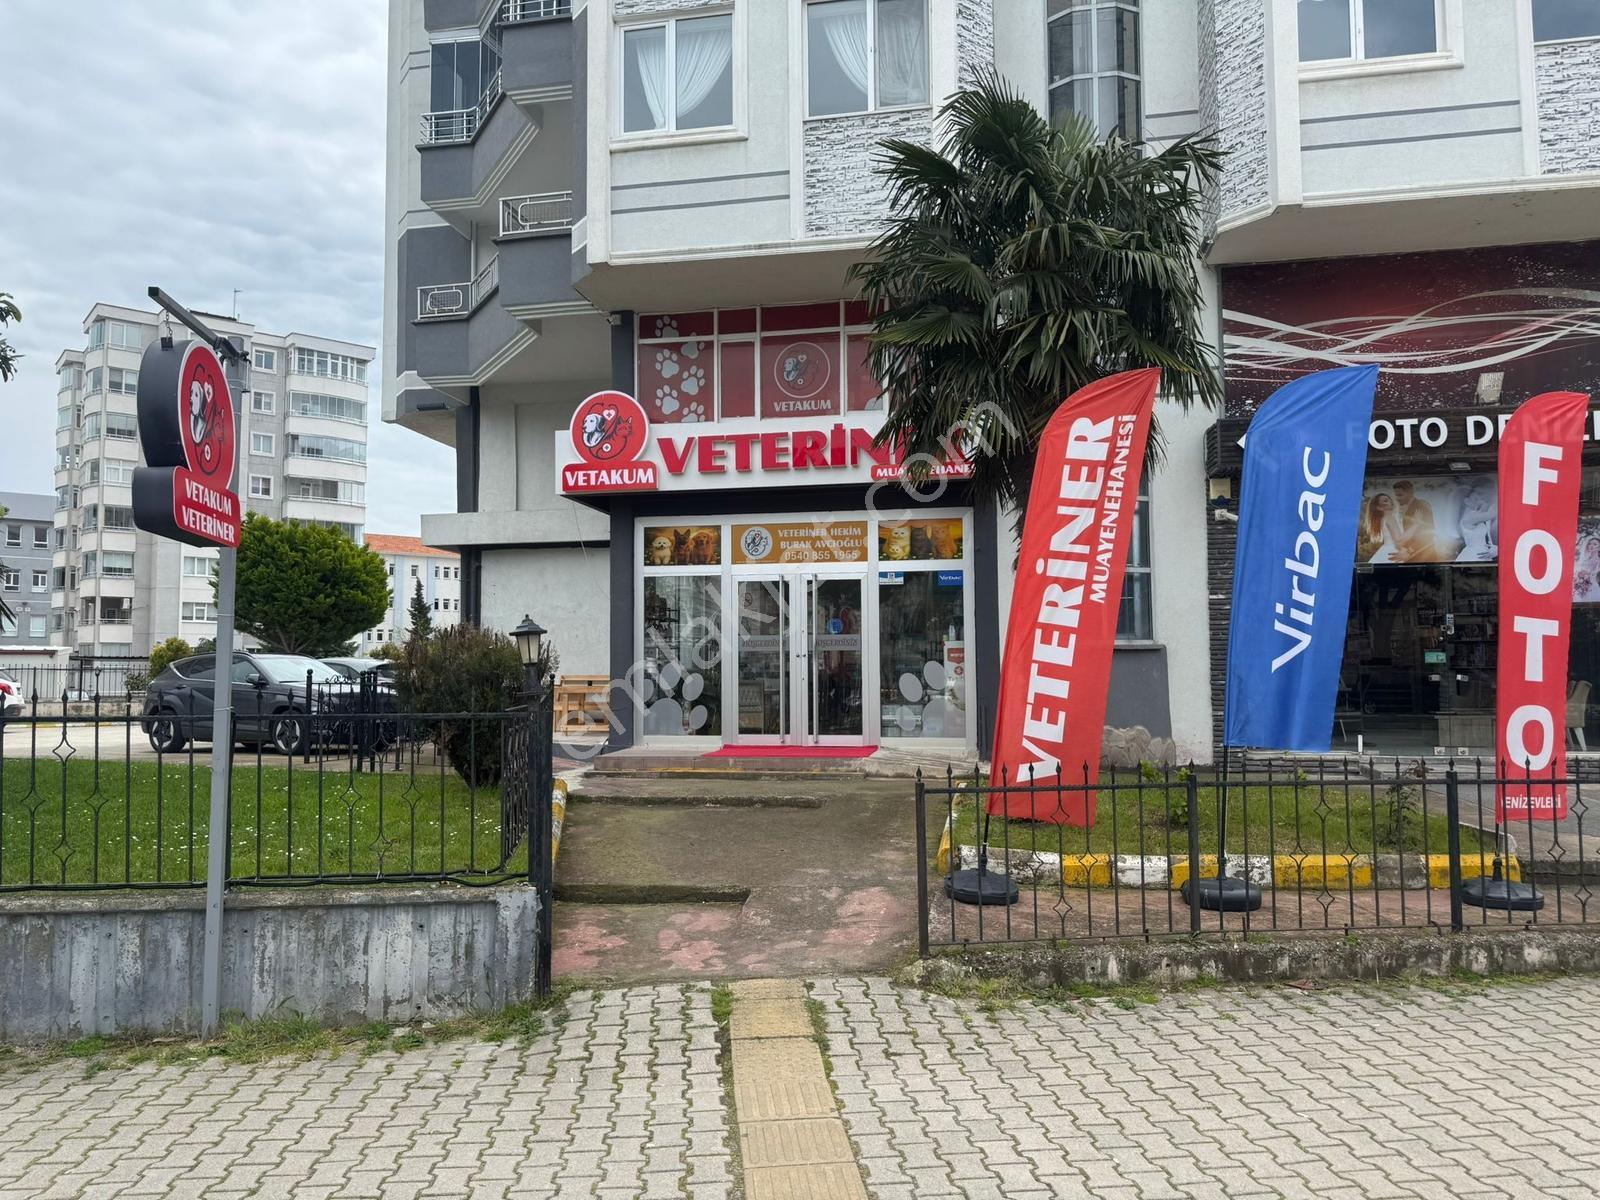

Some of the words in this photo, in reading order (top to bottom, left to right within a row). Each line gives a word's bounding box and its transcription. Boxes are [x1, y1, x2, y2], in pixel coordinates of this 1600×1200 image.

[774, 400, 832, 412] VETAKUM
[565, 468, 655, 487] VETAKUM
[184, 478, 232, 516] VETAKUM
[1090, 414, 1137, 604] MUAYENEHANESİ
[181, 505, 235, 543] VETERİNER
[831, 525, 862, 536] HEKİM
[784, 550, 810, 560] 0540
[1271, 446, 1330, 673] Virbac
[1016, 416, 1115, 783] VETERİNER
[1505, 440, 1563, 771] FOTO
